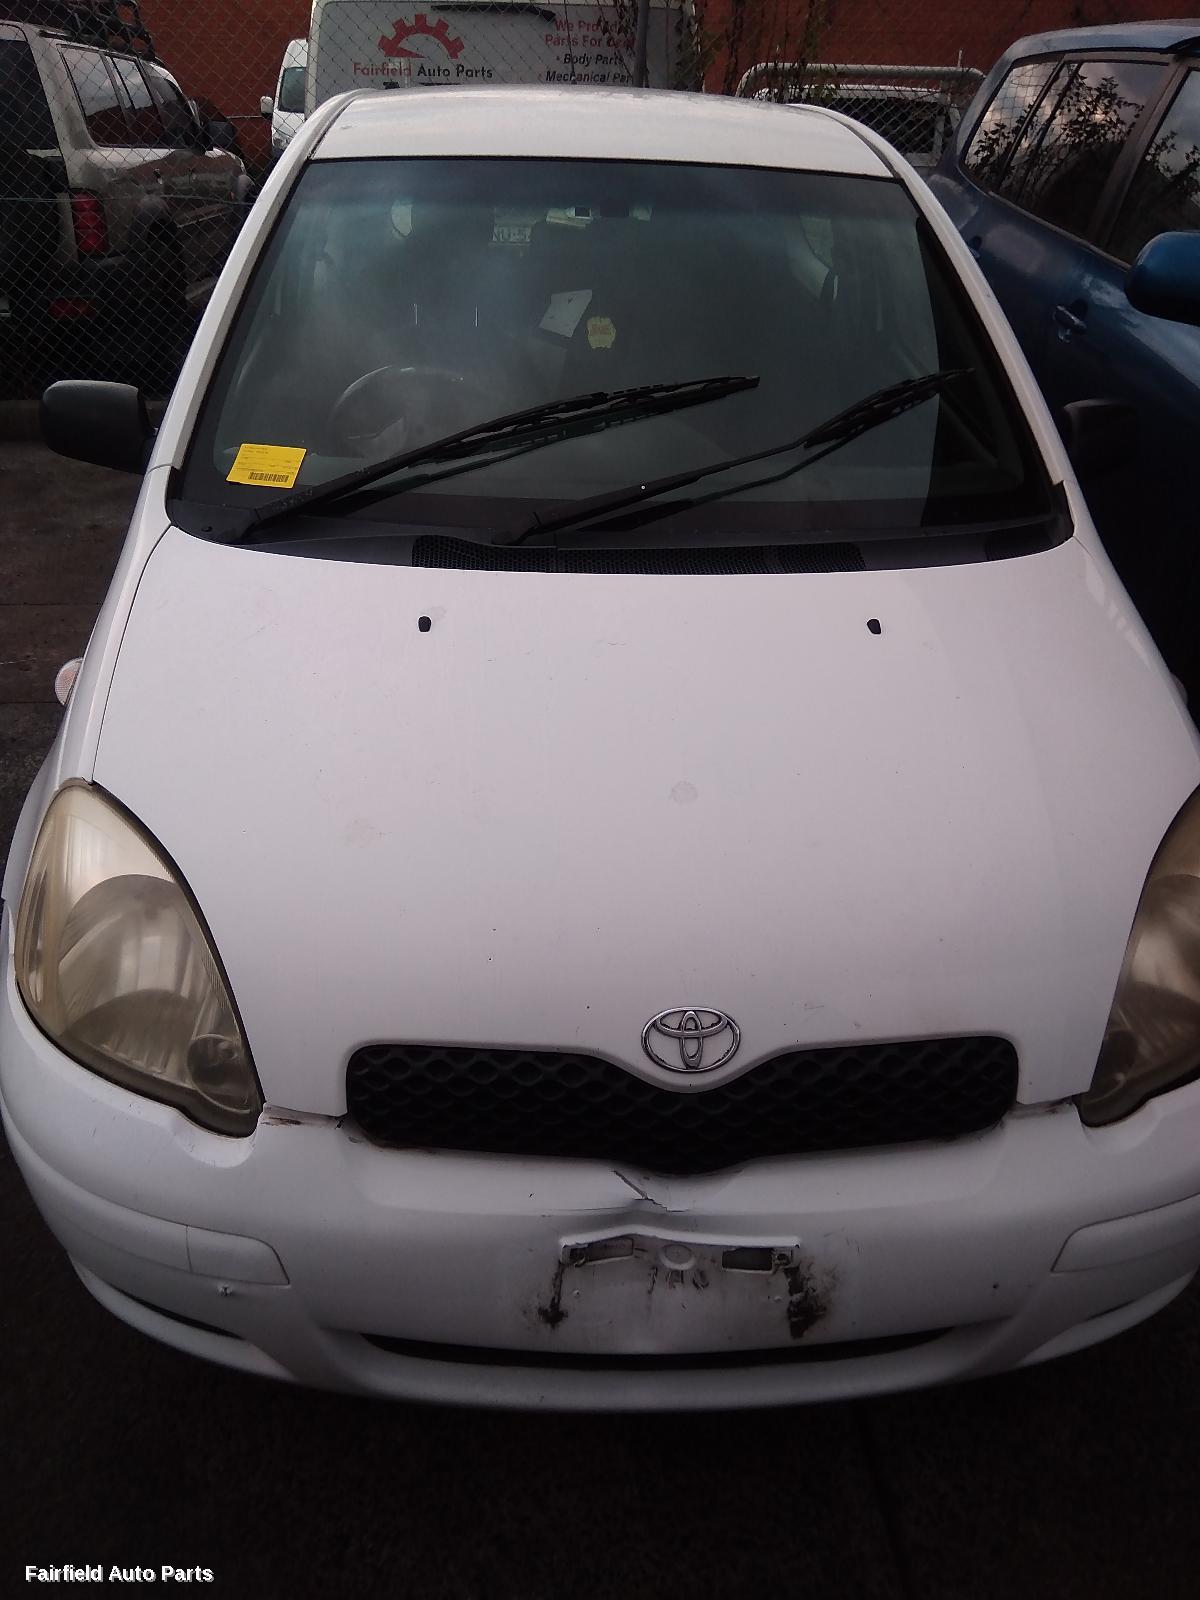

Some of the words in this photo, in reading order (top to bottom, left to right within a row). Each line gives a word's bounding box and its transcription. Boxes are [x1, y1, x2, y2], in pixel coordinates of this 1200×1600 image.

[555, 19, 574, 32] We
[545, 34, 579, 47] Parts
[583, 35, 604, 47] For
[563, 53, 592, 67] Body
[595, 54, 624, 66] Parts
[353, 62, 412, 77] Fairfield
[417, 64, 451, 77] Auto
[455, 64, 493, 79] Parts
[546, 70, 609, 83] Mechanical
